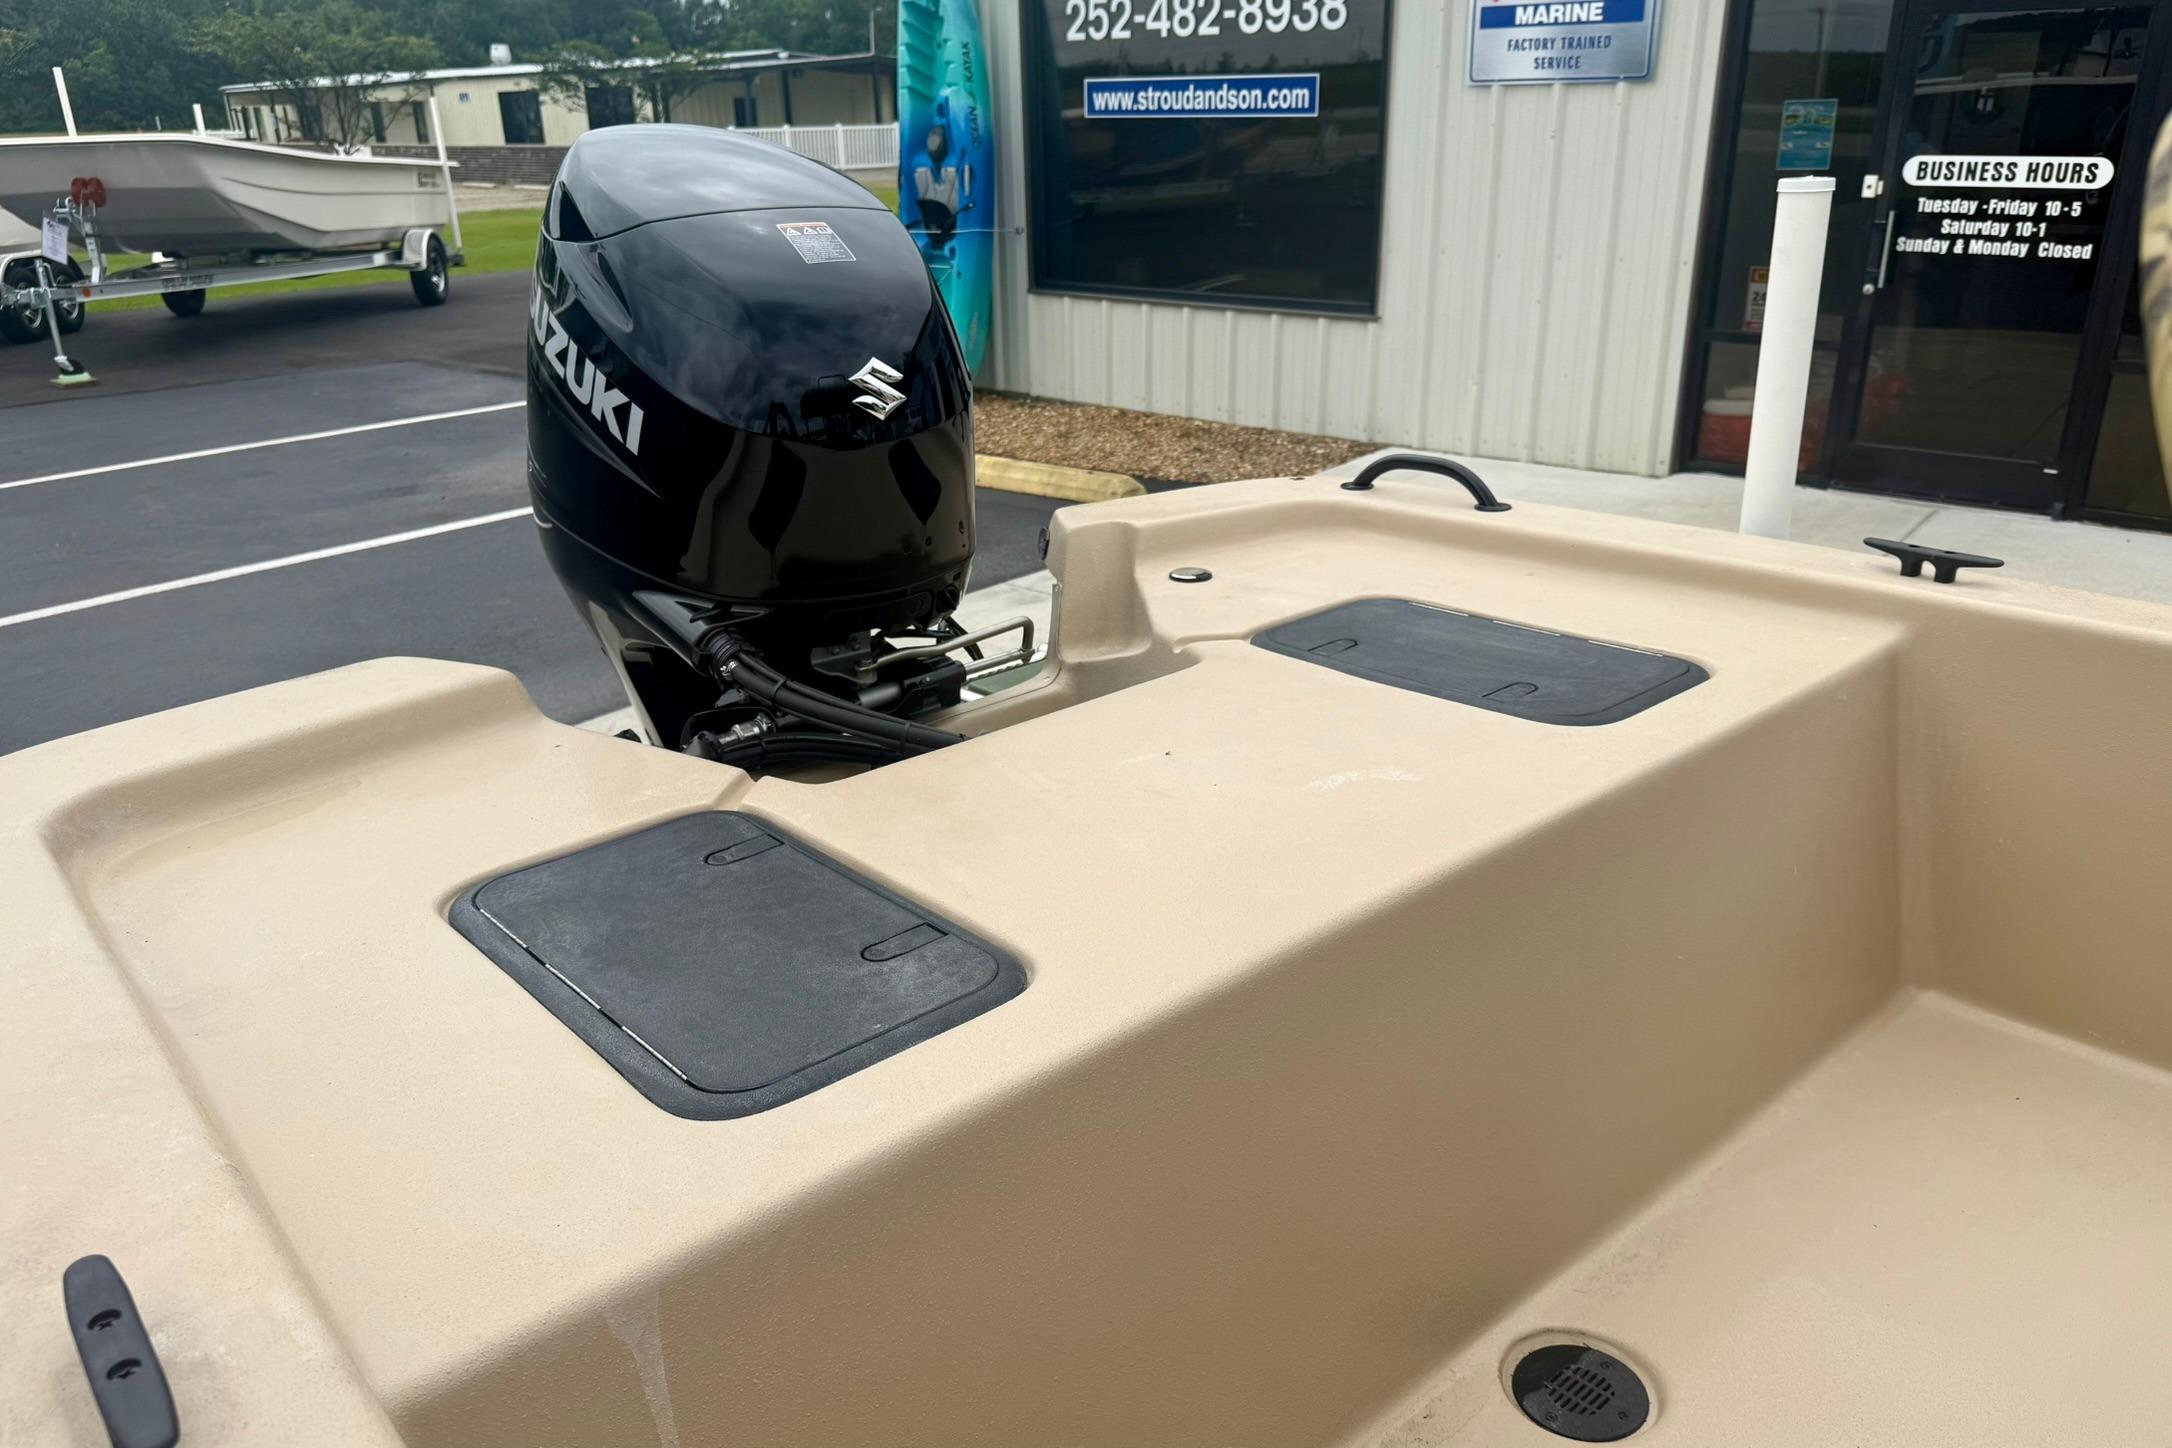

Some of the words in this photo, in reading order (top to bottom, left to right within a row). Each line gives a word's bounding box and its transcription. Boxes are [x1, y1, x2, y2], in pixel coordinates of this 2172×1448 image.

[1065, 0, 1348, 42] 252-482-8938
[1514, 2, 1605, 26] MARINE
[1507, 38, 1557, 52] FACTORY
[1561, 34, 1612, 50] TRAINED
[1533, 55, 1582, 71] SERVICE
[1092, 83, 1311, 112] www.stroudandson.com
[1915, 160, 2018, 183] BUSINESS
[2025, 161, 2099, 184] HOURS
[1916, 196, 1979, 216] Tuesday
[1940, 217, 2010, 238] Saturday
[2014, 220, 2047, 238] 10-1
[1896, 236, 1950, 255] Sunday
[1952, 237, 1965, 255] &
[1967, 239, 2030, 259] Monday
[2037, 241, 2094, 260] Closed
